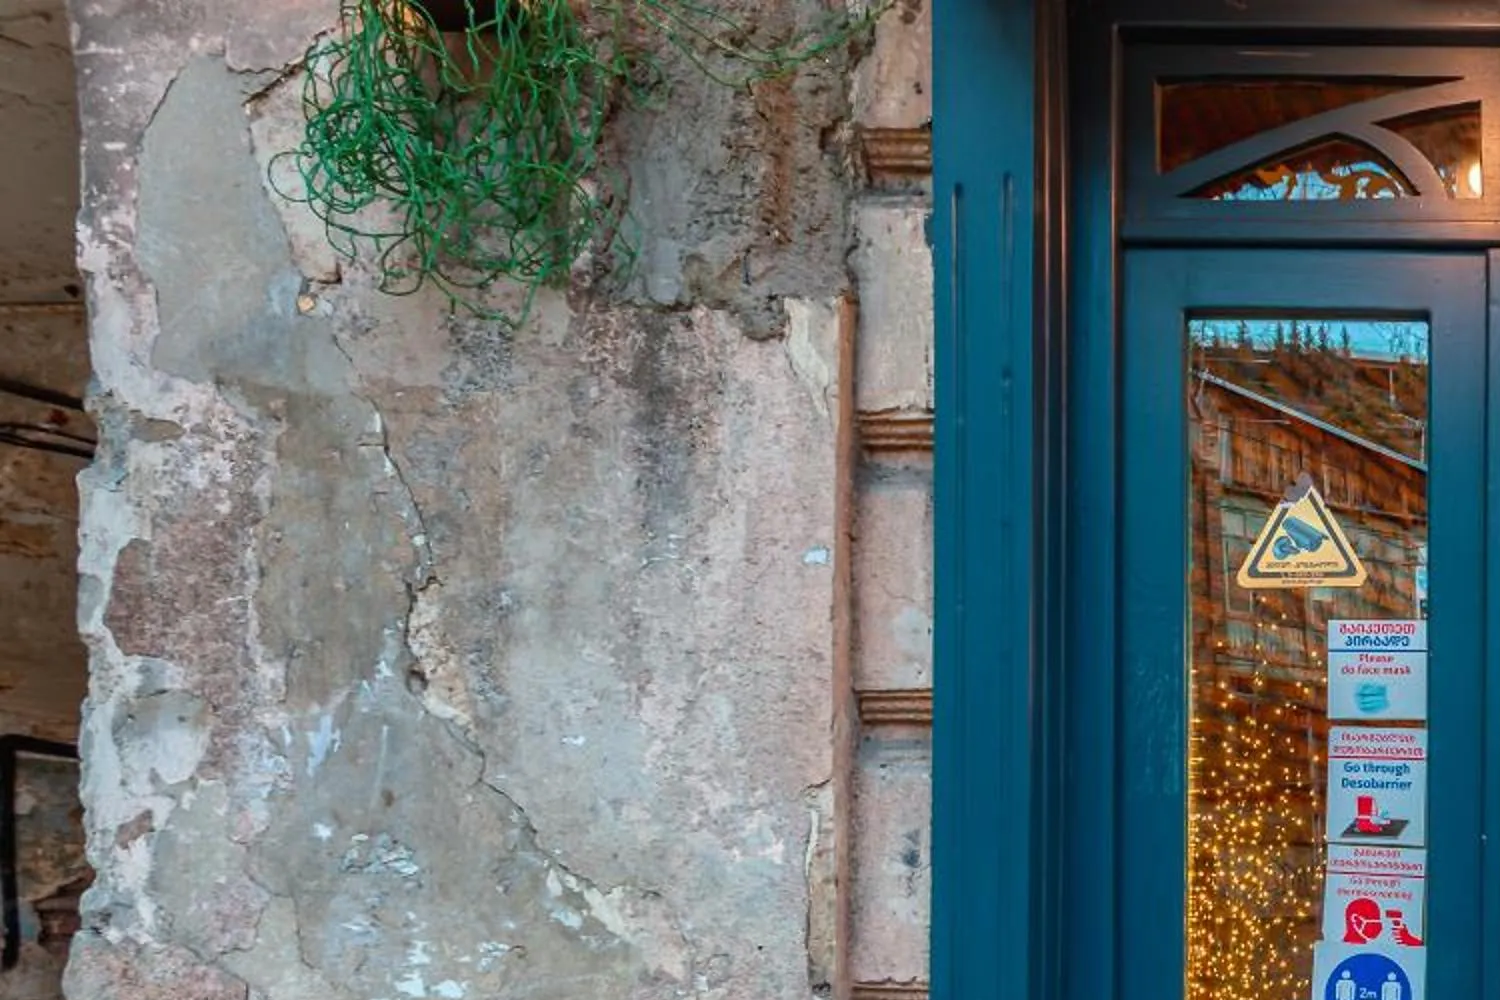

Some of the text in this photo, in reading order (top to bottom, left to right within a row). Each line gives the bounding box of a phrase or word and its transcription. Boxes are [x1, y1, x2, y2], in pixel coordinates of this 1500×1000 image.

[1343, 762, 1411, 776] Go through
[1341, 778, 1412, 790] Desobarrier
[1360, 987, 1377, 999] 2m
